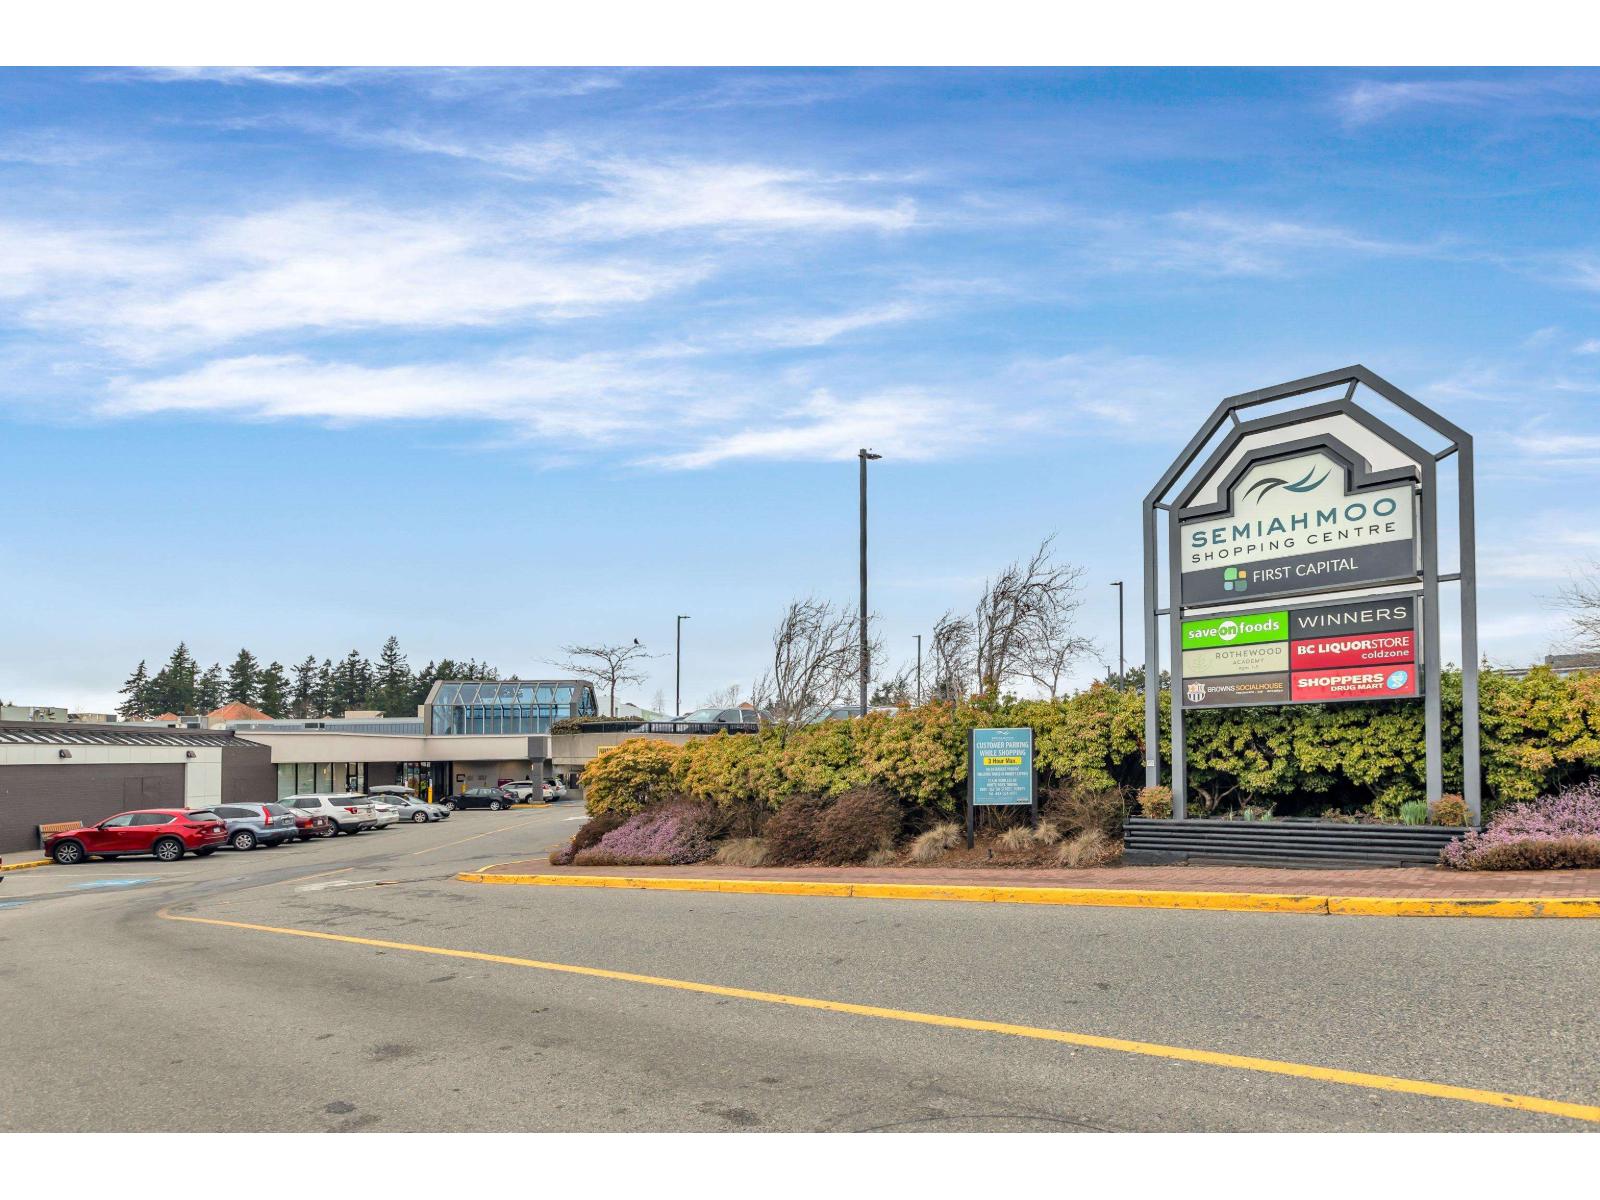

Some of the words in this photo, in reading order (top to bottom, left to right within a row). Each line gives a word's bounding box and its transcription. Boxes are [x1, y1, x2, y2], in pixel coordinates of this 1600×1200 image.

[1191, 497, 1397, 548] SEMIAHMOO
[1191, 538, 1295, 563] SHOPPING
[1307, 522, 1396, 544] CENTRE
[1253, 566, 1292, 582] FIRST
[1296, 557, 1358, 577] CAPITAL
[1298, 606, 1407, 629] WINNERS
[1215, 647, 1282, 660] ROTHEWOOD
[1297, 644, 1315, 655] BC
[1361, 649, 1410, 660] coldzone
[1297, 673, 1385, 688] SHOPPERS
[1207, 685, 1235, 693] BROWNS
[1331, 684, 1356, 692] DRUG
[1357, 682, 1383, 690] MART
[976, 741, 1005, 749] CUSTOMER
[980, 749, 997, 757] WHILE
